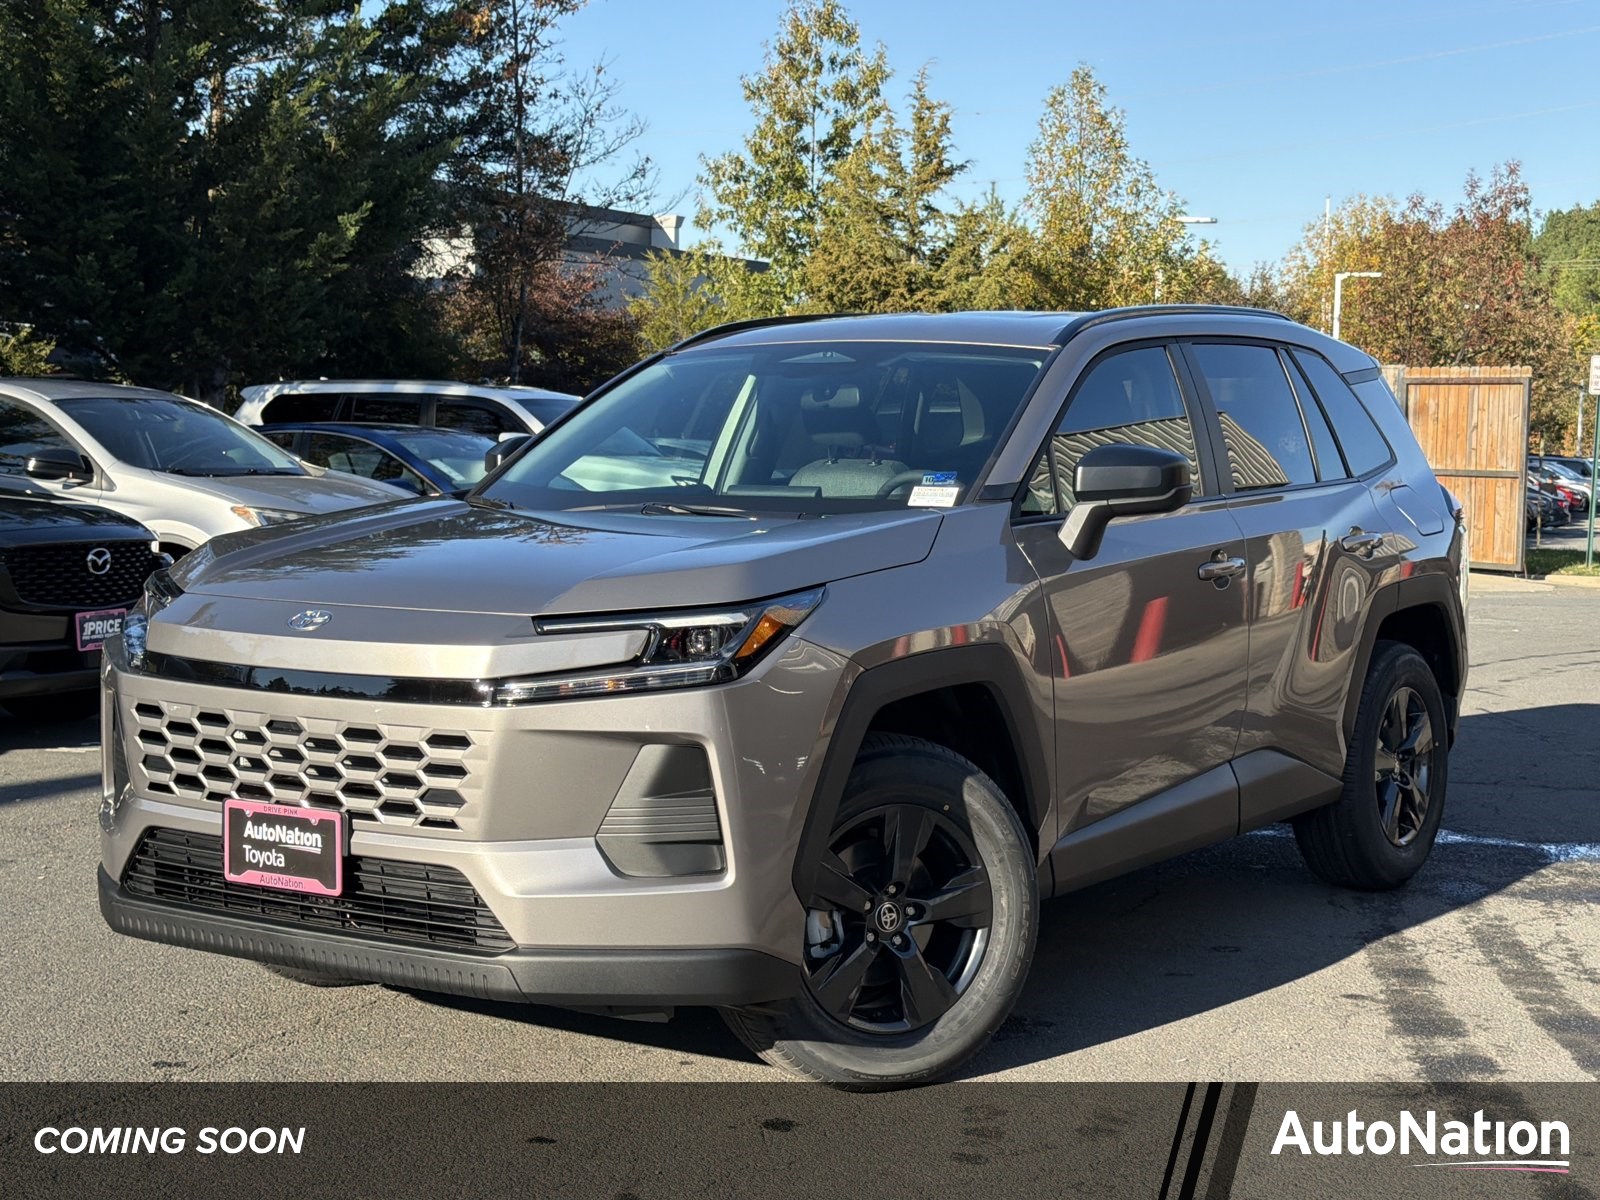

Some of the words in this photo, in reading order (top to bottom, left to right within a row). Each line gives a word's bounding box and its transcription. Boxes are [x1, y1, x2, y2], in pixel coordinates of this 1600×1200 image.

[263, 805, 282, 814] DRIVE
[243, 820, 323, 848] AutoNation
[242, 844, 285, 868] Toyota
[259, 875, 304, 889] AutoNation
